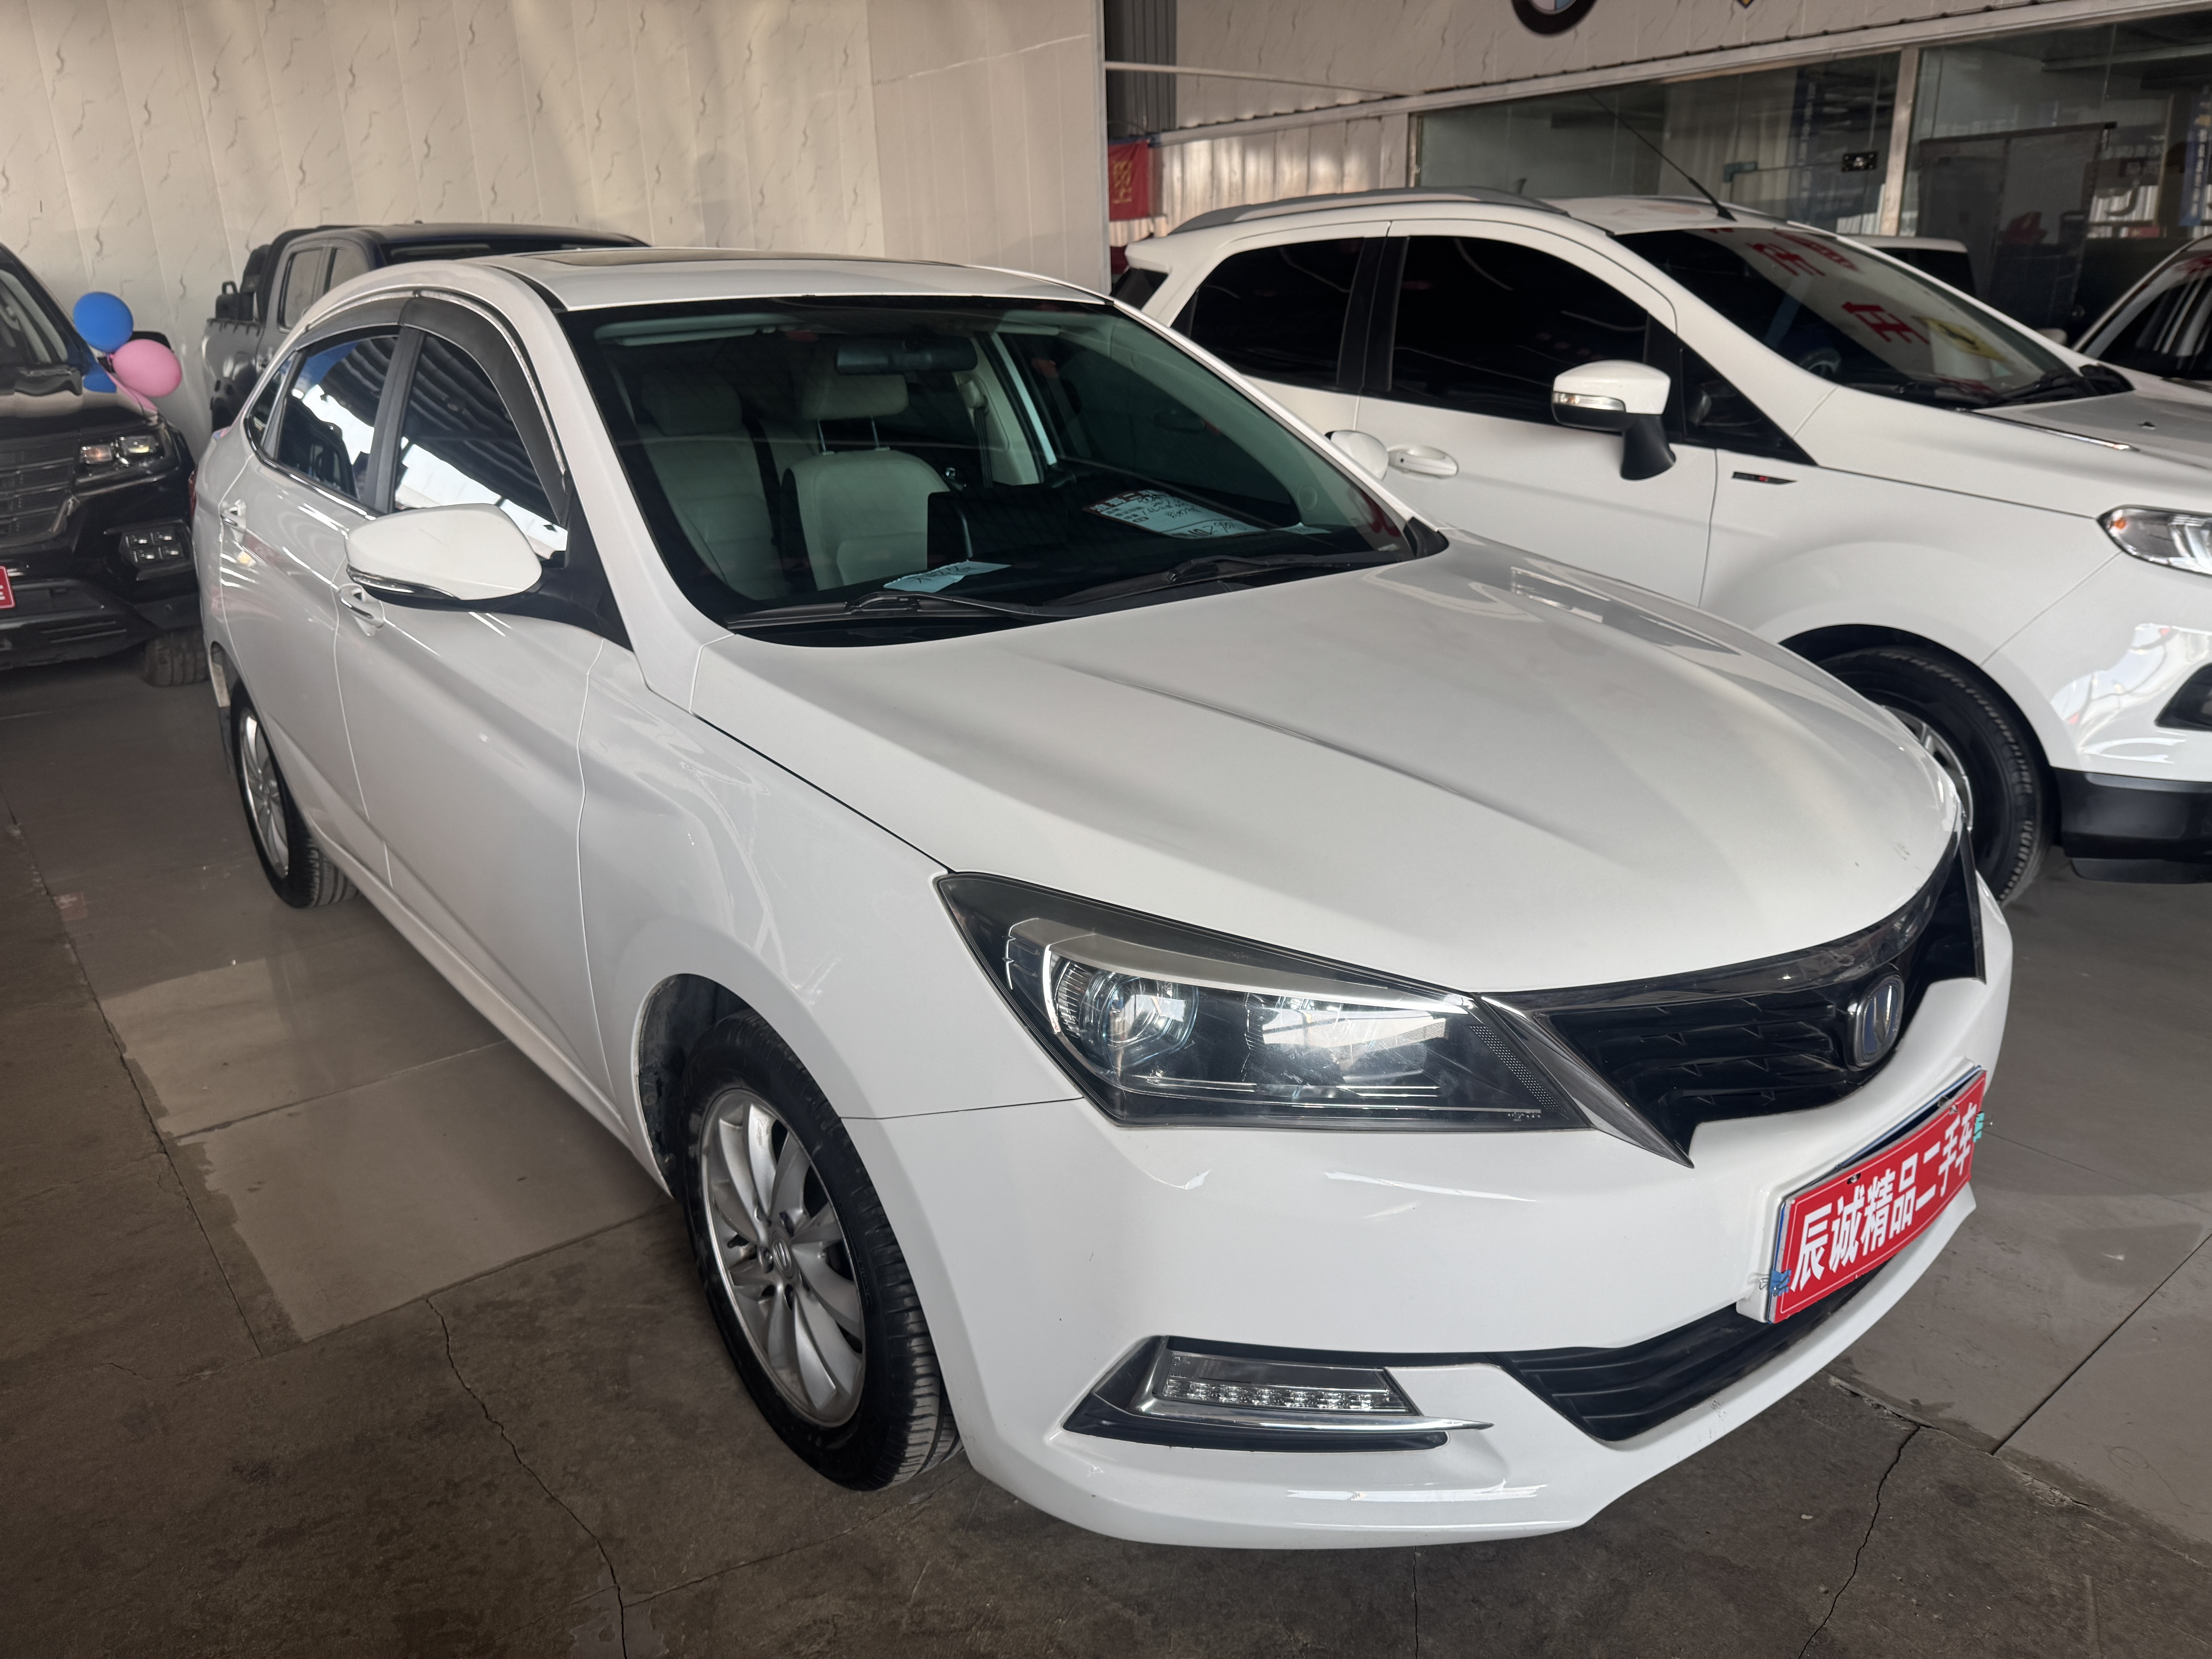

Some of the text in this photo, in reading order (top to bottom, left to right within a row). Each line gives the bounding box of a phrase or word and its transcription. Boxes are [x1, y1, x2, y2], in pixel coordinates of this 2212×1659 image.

[1790, 1102, 1977, 1291] 辰诚精品二手车
